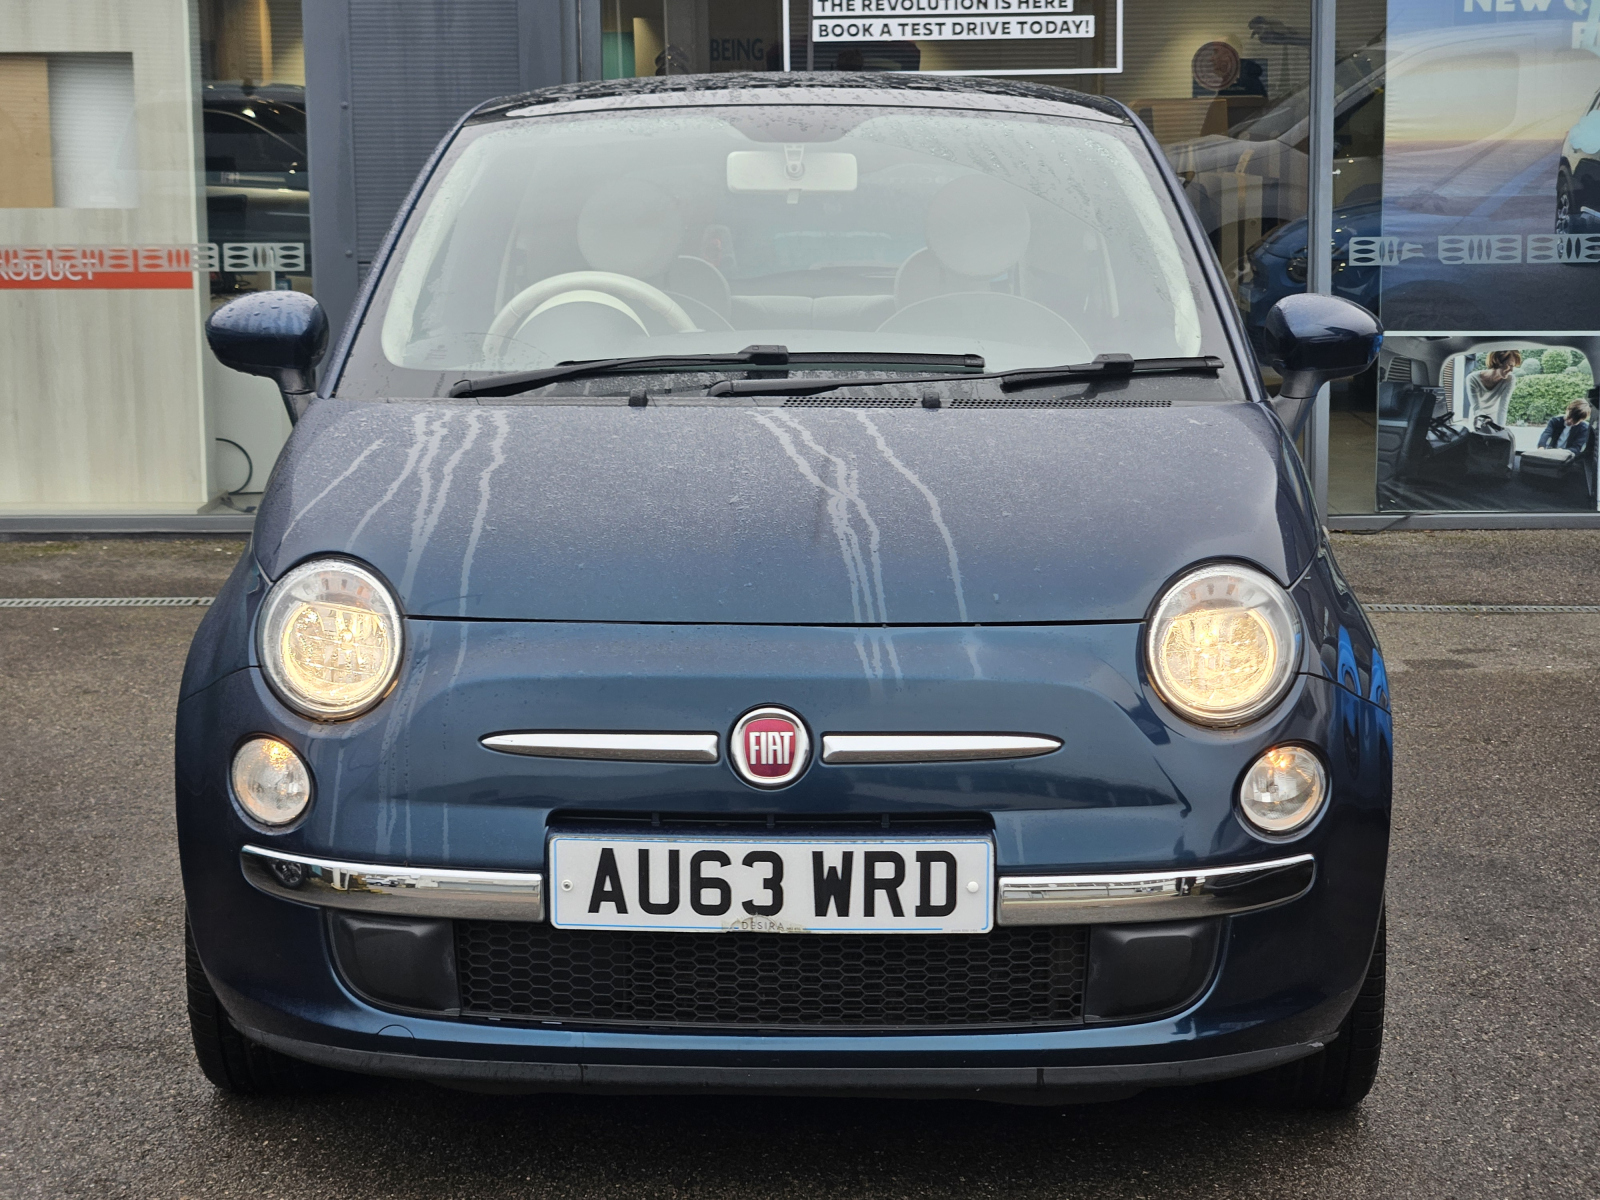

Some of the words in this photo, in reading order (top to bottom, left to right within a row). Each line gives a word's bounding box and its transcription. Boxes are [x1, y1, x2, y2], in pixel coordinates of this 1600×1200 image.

[817, 0, 856, 12] THE
[861, 0, 989, 12] REVOLUTION
[994, 0, 1012, 10] IS
[1017, 0, 1068, 10] HERE
[818, 23, 873, 38] BOOK
[879, 23, 892, 37] A
[898, 22, 946, 37] TEST
[952, 21, 1011, 36] DRIVE
[1016, 19, 1090, 35] TODAY!
[709, 38, 764, 62] BEING
[749, 731, 794, 766] FIAT
[587, 847, 784, 917] AU63
[812, 849, 957, 918] WRD
